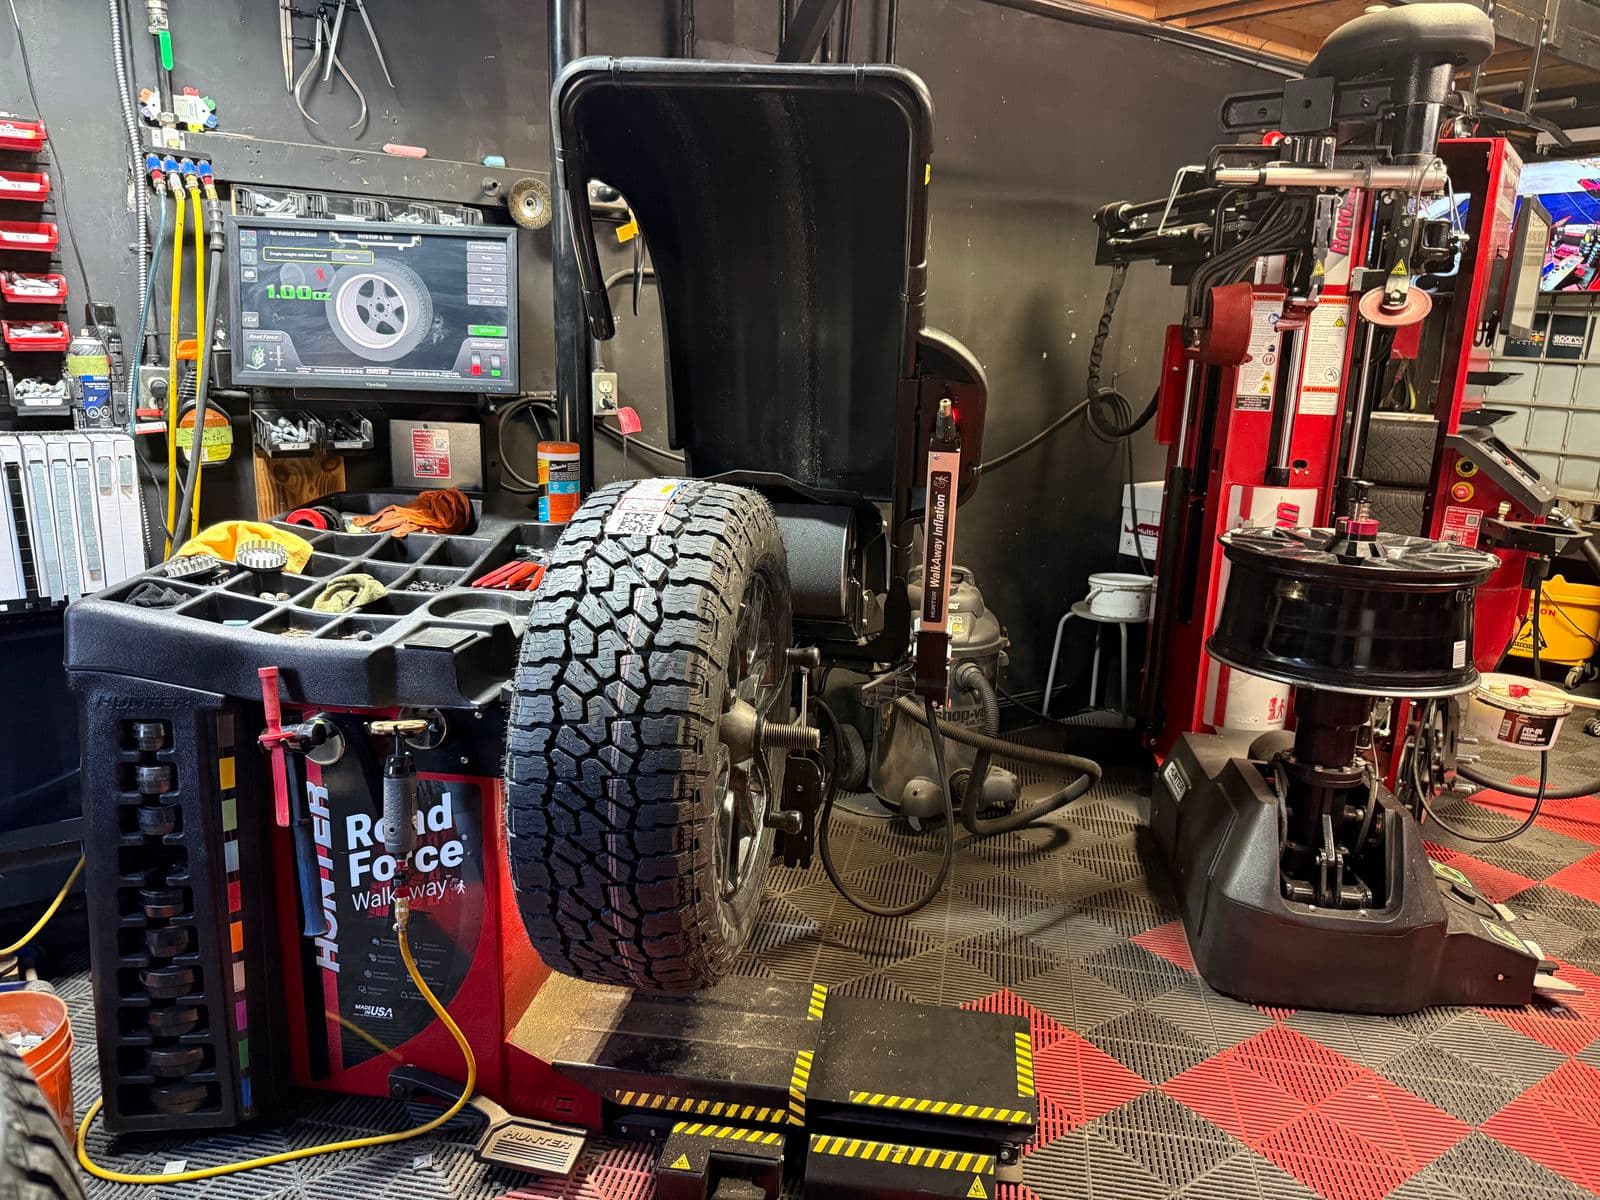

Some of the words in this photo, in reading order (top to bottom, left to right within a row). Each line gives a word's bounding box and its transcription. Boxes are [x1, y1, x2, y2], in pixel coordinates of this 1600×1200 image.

[933, 494, 946, 533] Inflation
[930, 539, 945, 588] WalkAway
[346, 792, 453, 850] Rd
[349, 839, 464, 887] Foce
[352, 878, 447, 912] Walkway
[355, 1004, 372, 1012] MADE
[371, 1006, 393, 1018] USA
[503, 1130, 573, 1150] HUNTER
